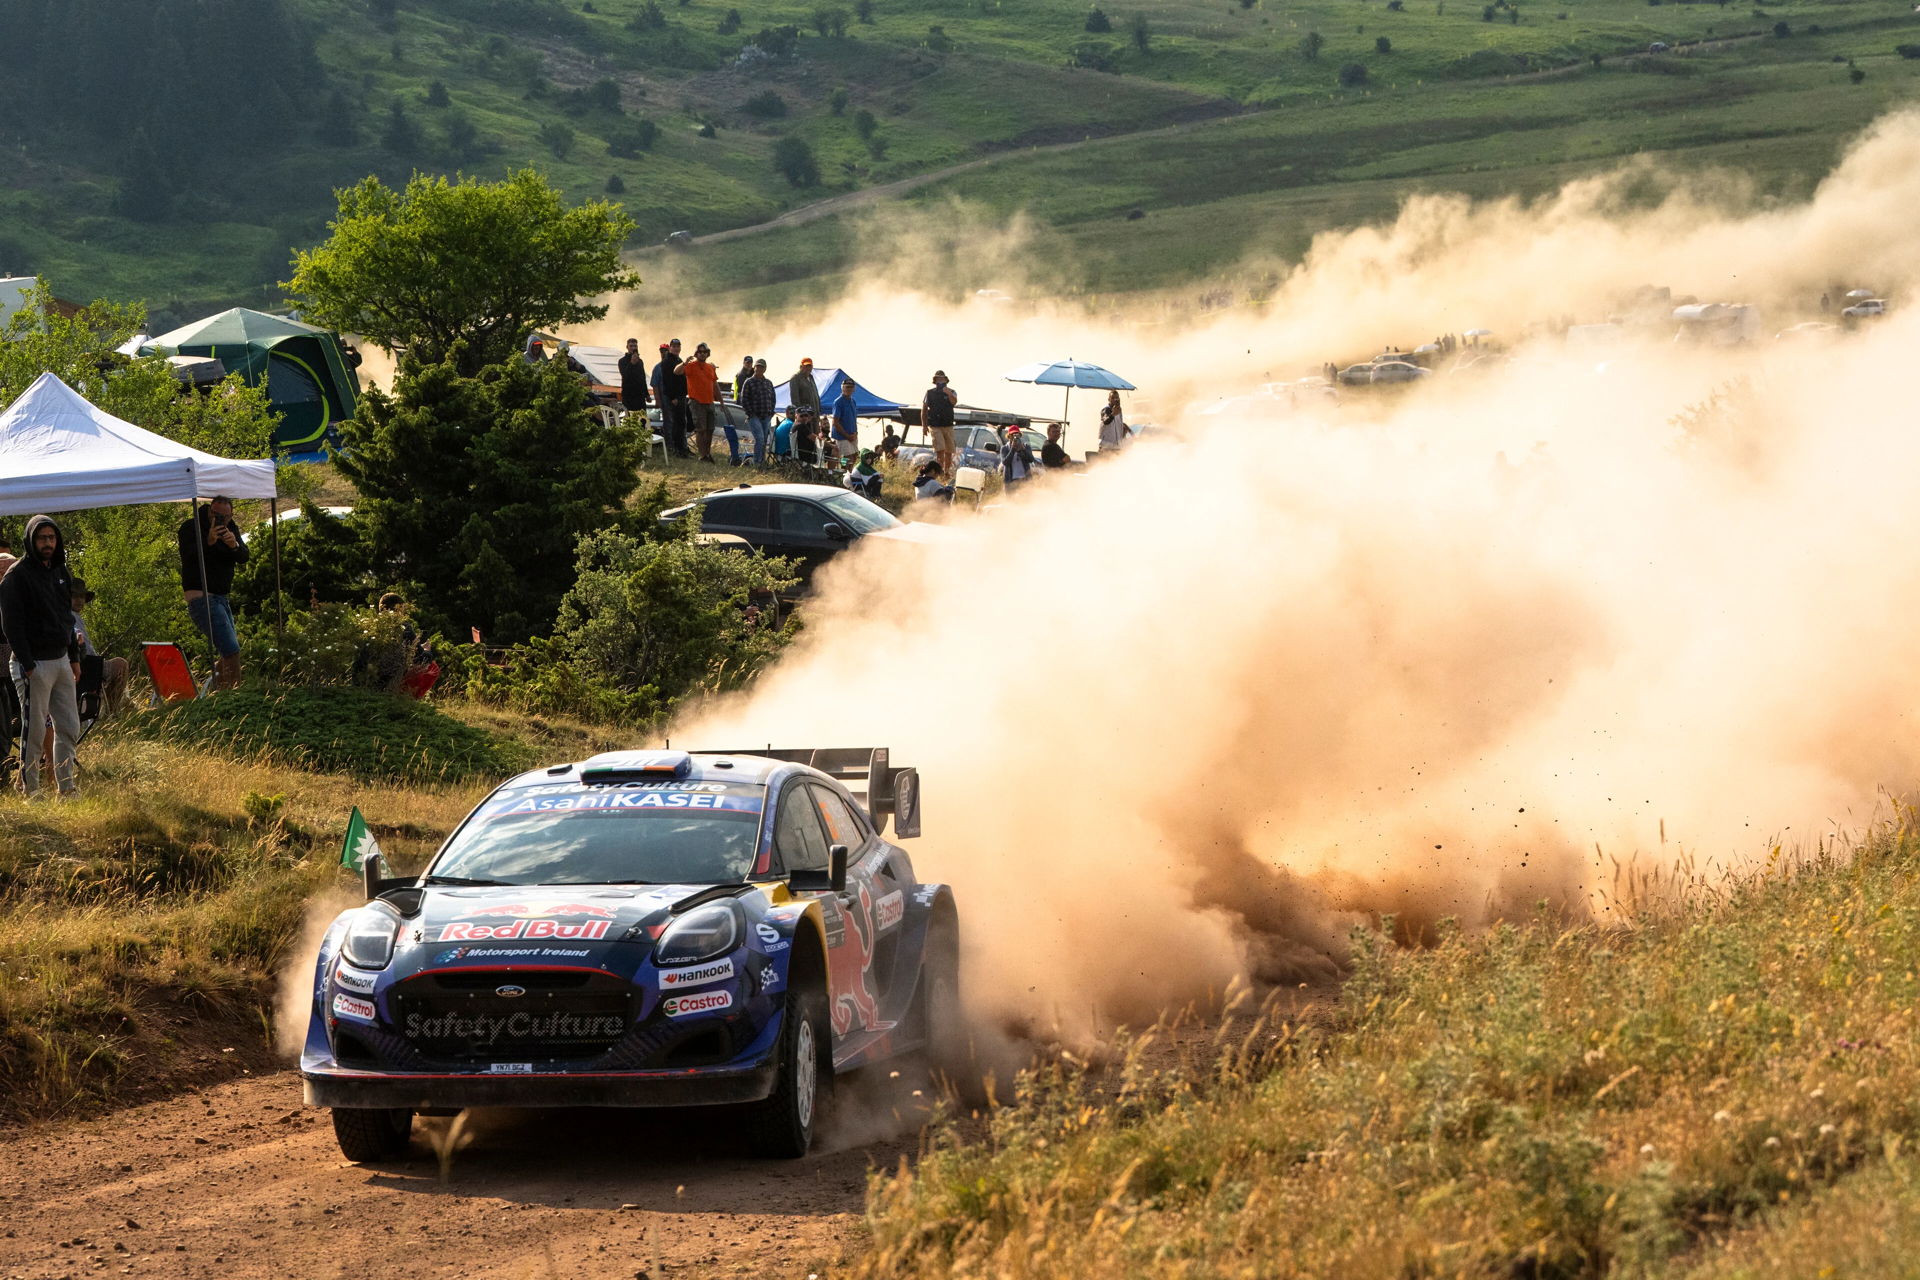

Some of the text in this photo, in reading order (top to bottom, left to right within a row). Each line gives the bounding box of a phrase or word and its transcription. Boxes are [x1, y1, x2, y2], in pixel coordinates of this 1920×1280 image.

[438, 920, 613, 941] Red Bull
[466, 947, 590, 957] Motorsport Ireland
[341, 998, 373, 1017] Castrol
[679, 994, 729, 1012] Castrol
[405, 1012, 624, 1045] SafetyCulture
